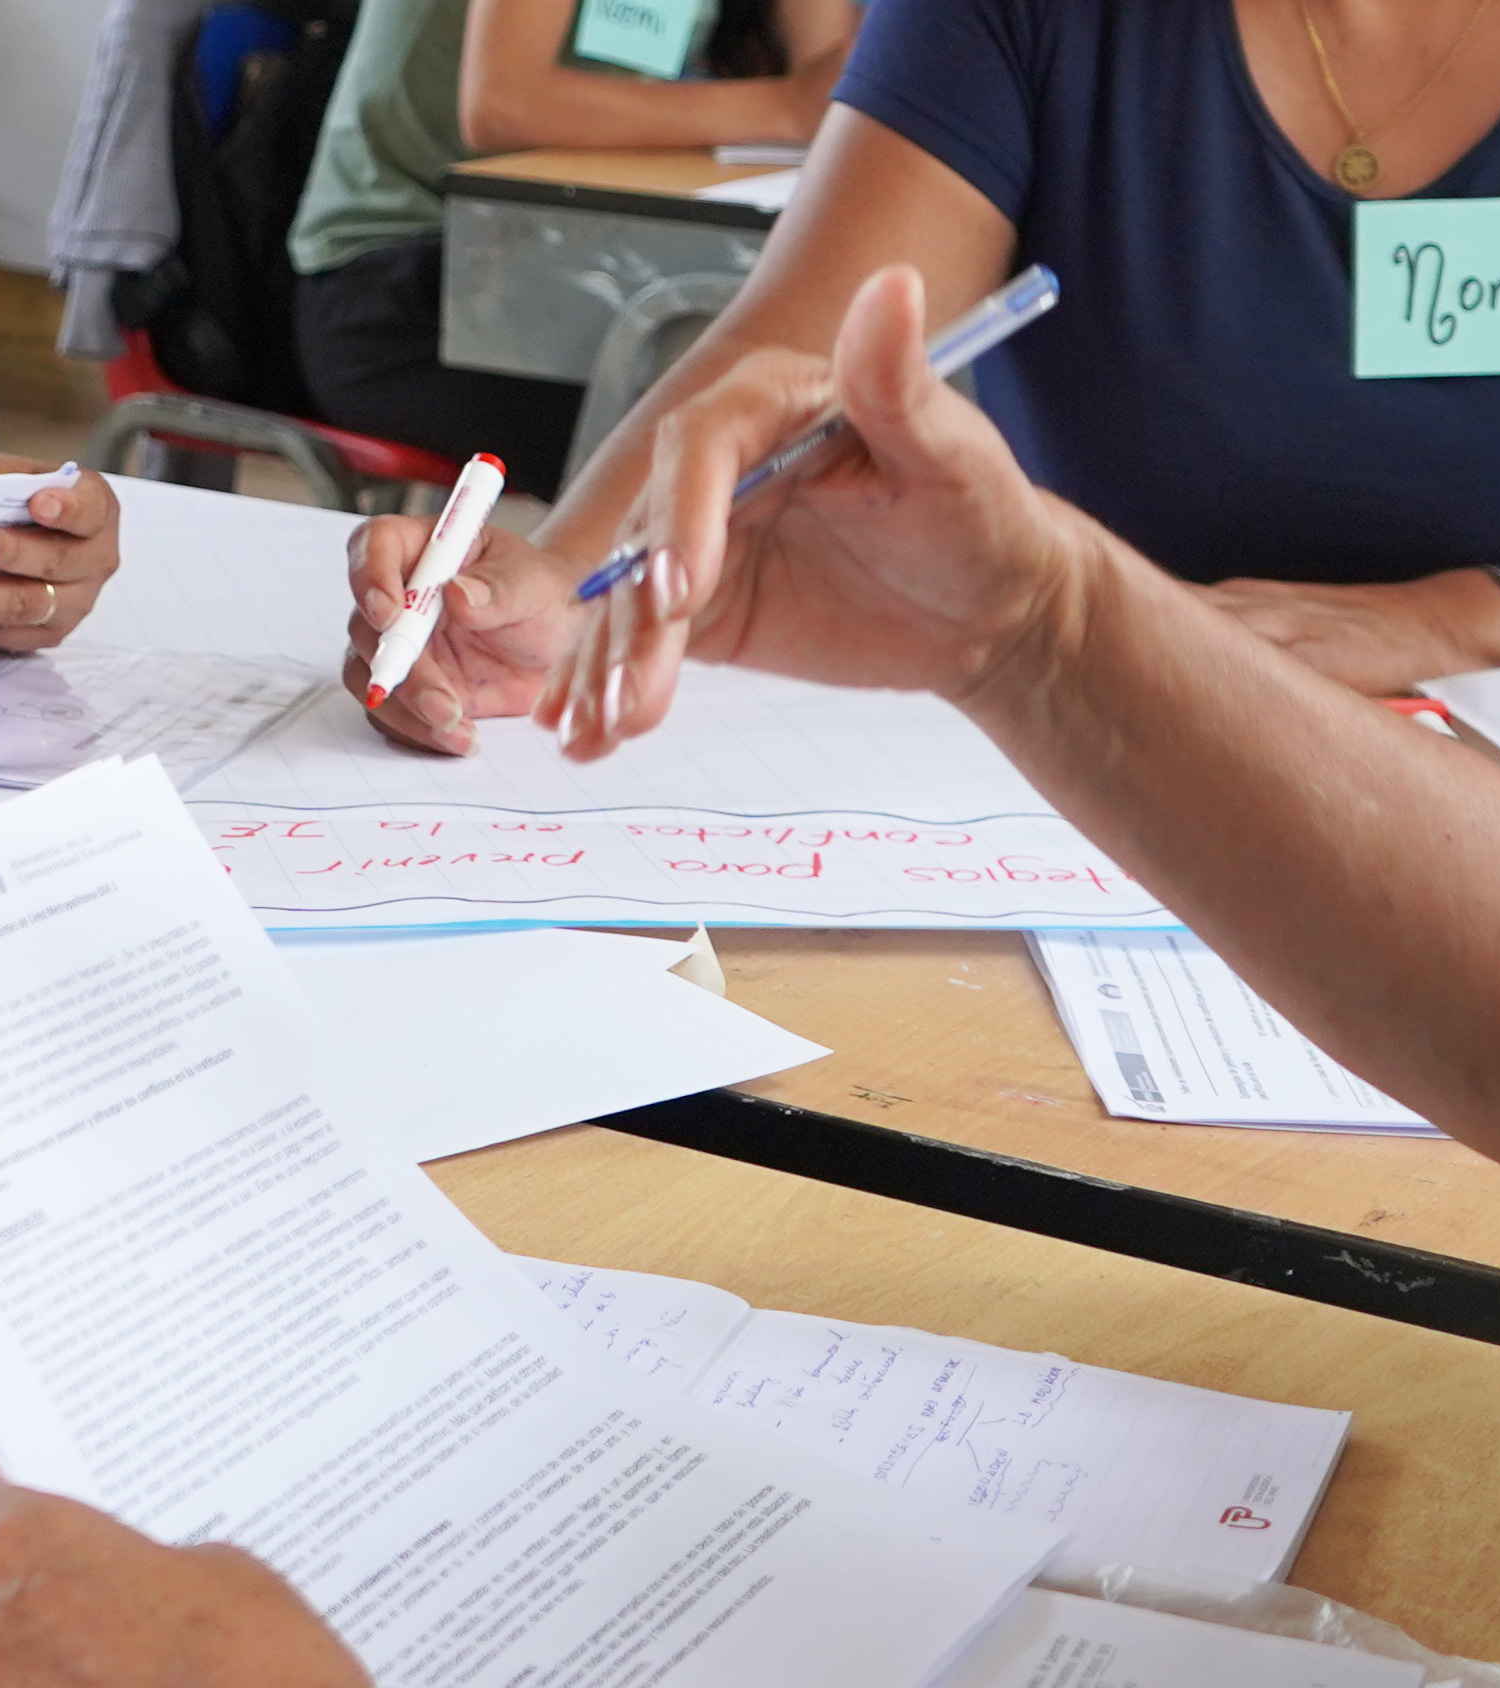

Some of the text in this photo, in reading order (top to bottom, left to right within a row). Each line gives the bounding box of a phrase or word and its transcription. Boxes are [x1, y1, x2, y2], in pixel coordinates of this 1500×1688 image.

[218, 820, 974, 850] conflictos en la IE
[295, 848, 587, 878] prevenir
[661, 852, 822, 881] para
